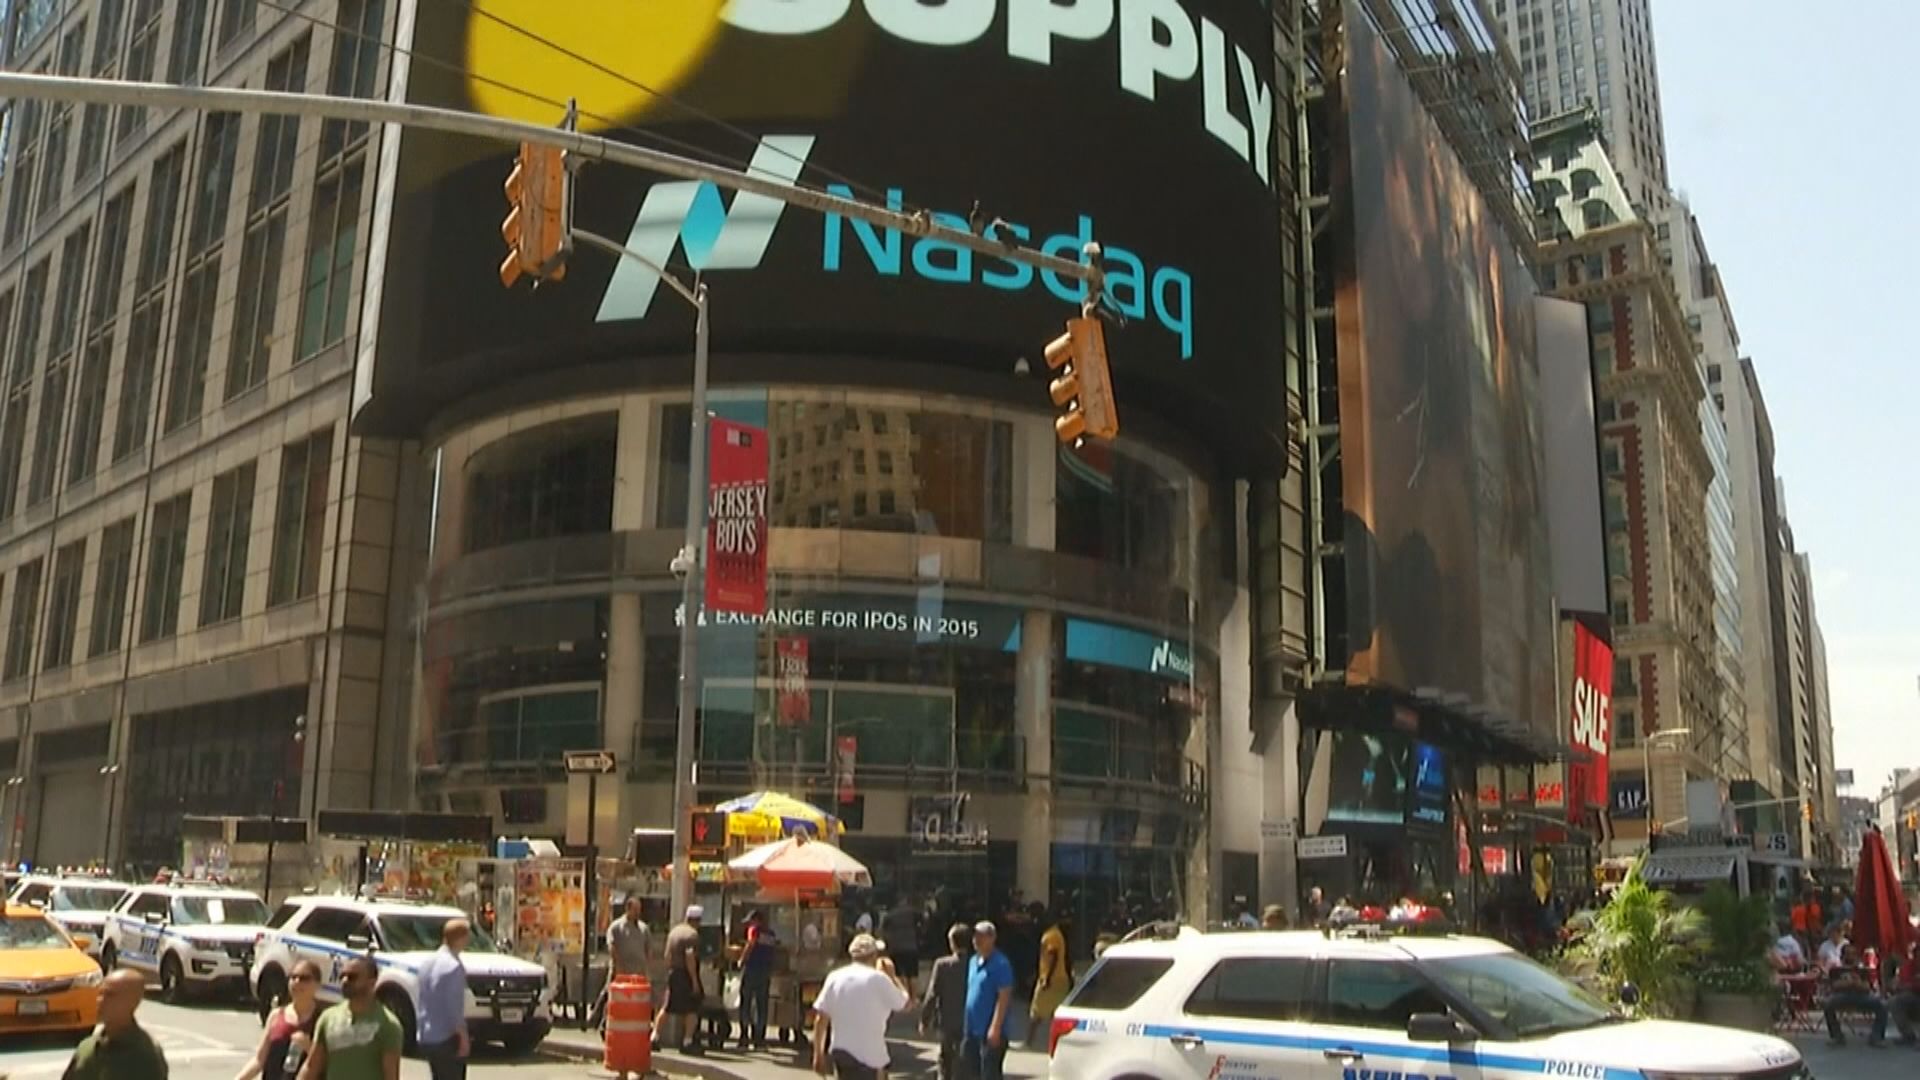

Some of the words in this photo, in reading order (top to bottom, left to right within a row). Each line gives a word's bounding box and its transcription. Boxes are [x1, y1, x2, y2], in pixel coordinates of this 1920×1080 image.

[822, 183, 1193, 360] Nasdaq
[708, 485, 767, 521] JERSEY
[716, 518, 758, 555] BOYS
[716, 608, 816, 626] EXCHANGE
[821, 609, 858, 629] FOR
[913, 615, 932, 633] IN
[938, 617, 979, 639] 2015
[1573, 676, 1609, 756] SALE
[1617, 789, 1642, 809] GAP
[1546, 1059, 1604, 1080] POLICE
